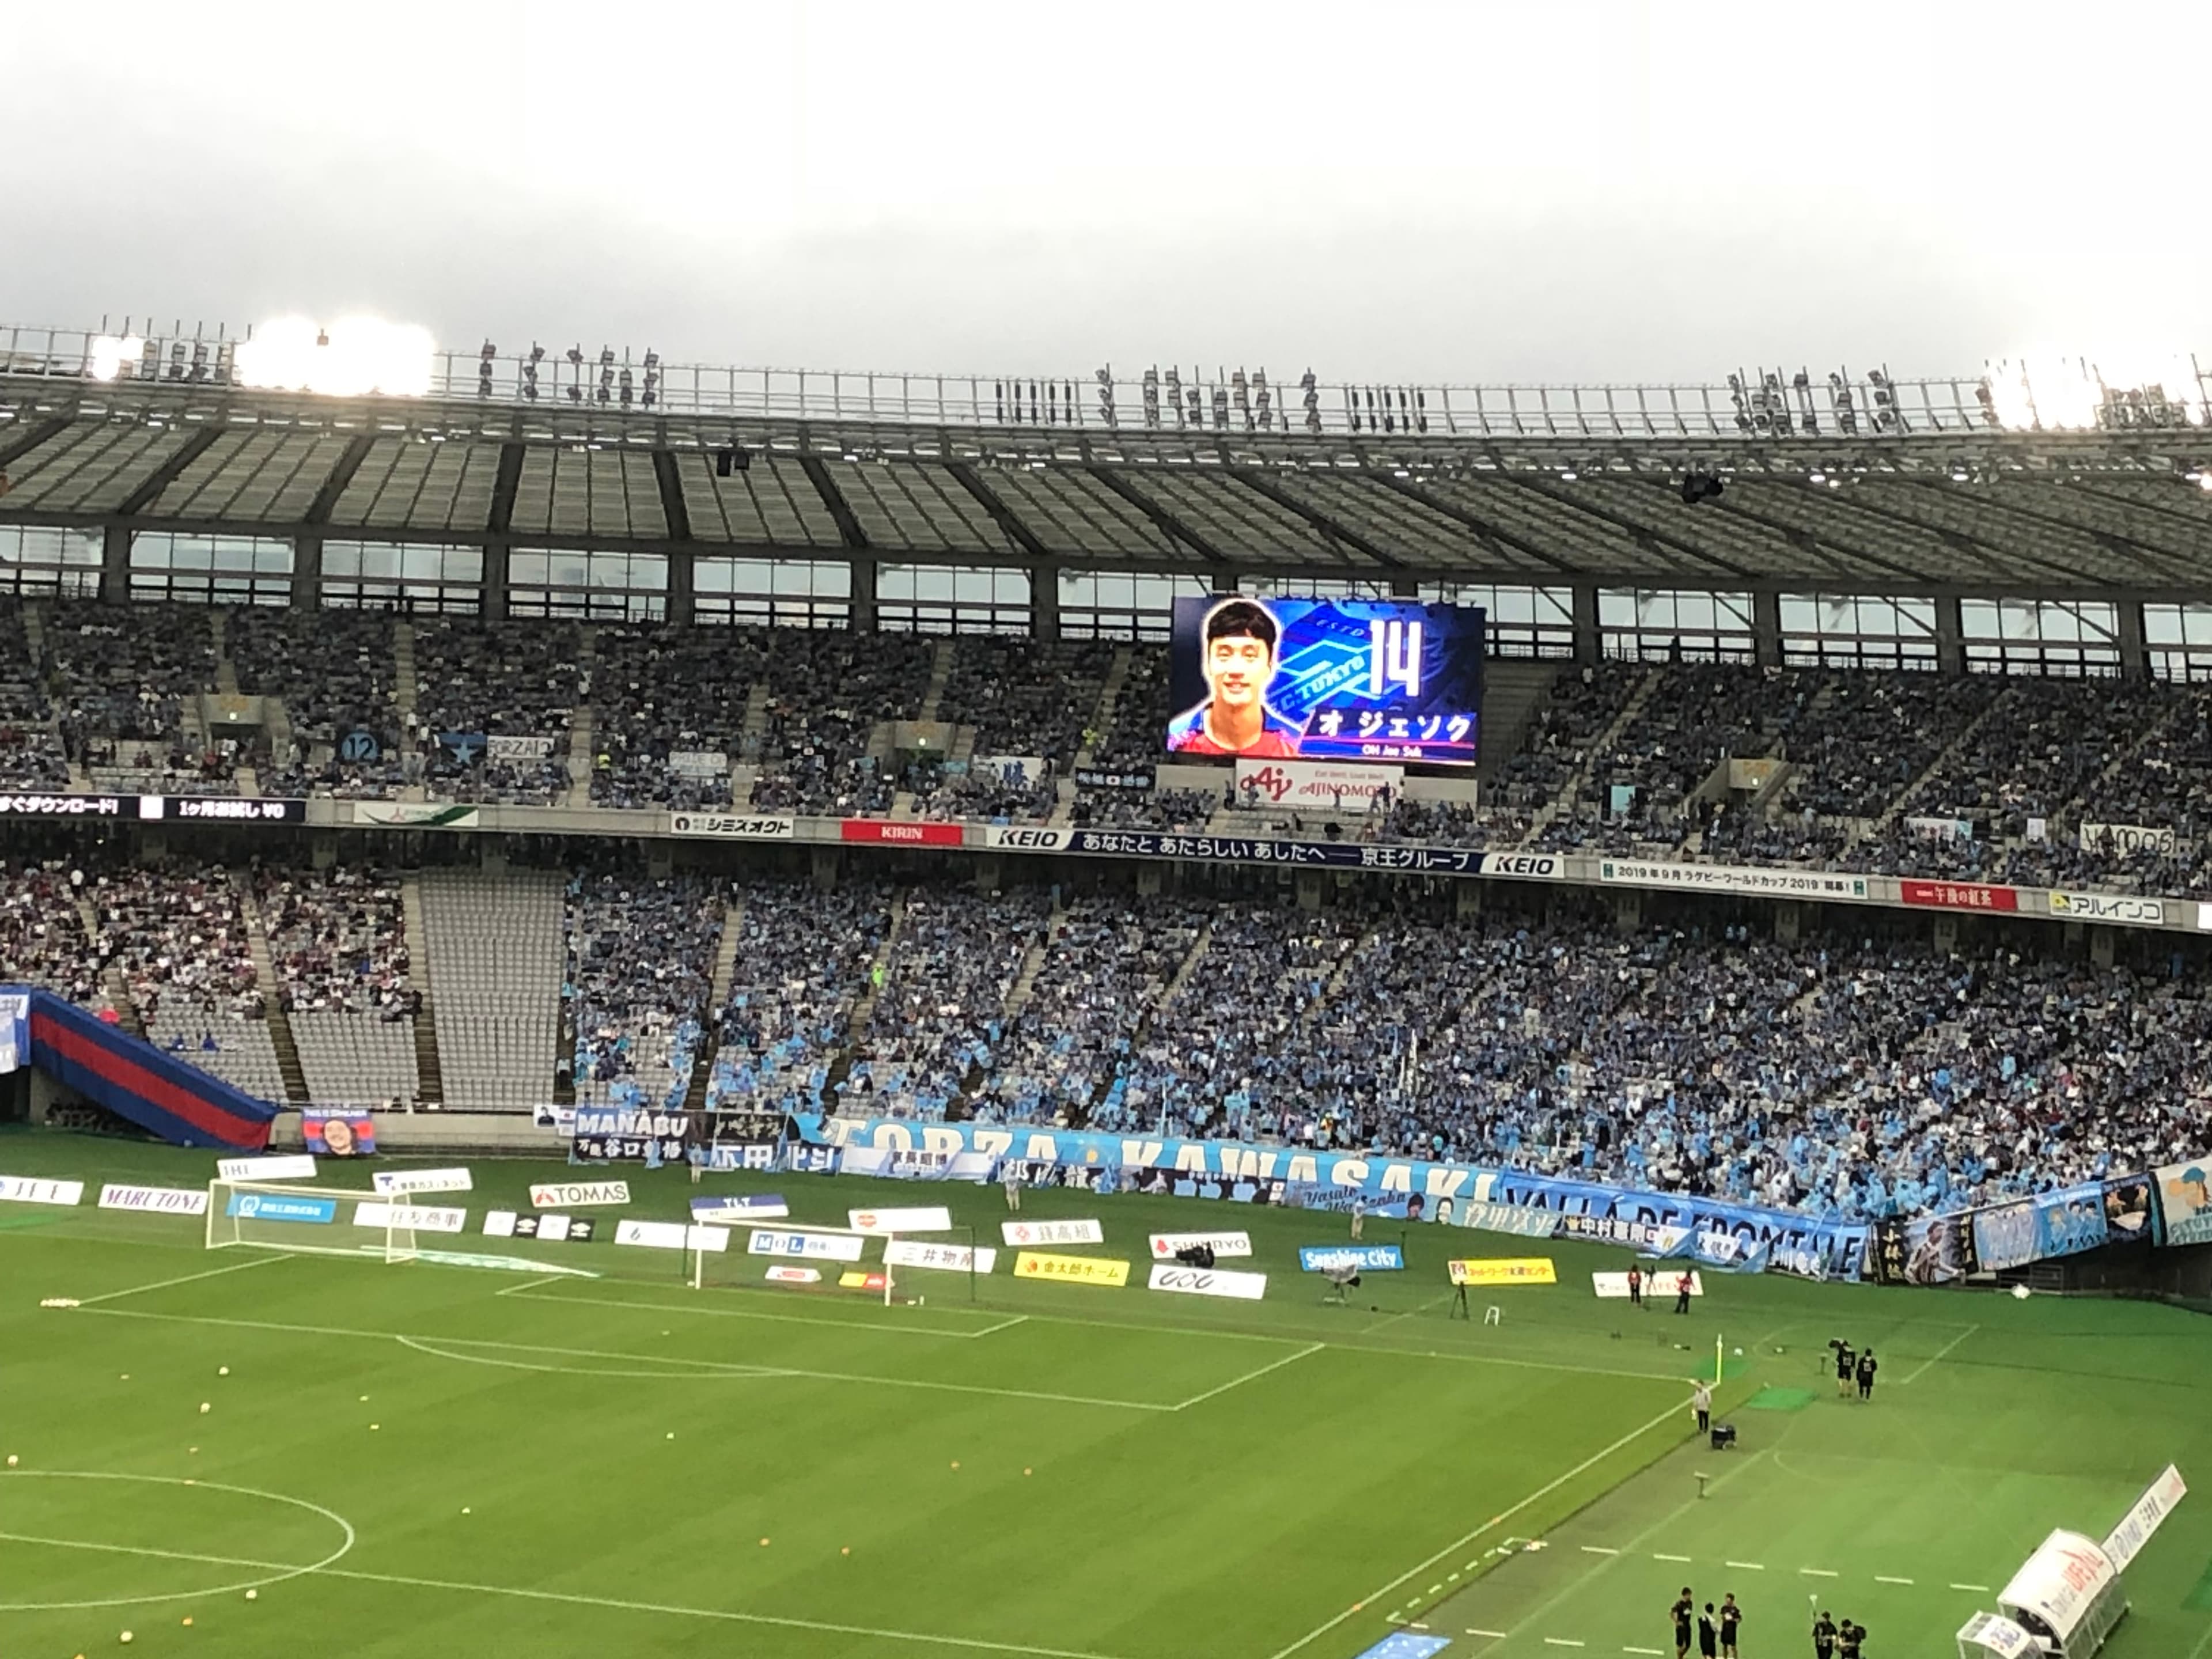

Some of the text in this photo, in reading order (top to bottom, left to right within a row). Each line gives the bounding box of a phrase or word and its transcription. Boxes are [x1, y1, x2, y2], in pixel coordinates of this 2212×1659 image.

[1370, 620, 1422, 697] 14
[1298, 782, 1397, 798] AJINOMOO
[881, 827, 923, 839] KIRIN
[998, 830, 1059, 847] KEIO
[1083, 834, 1469, 870] あなたと あたらしい あしたへ 京王グループ
[1494, 856, 1554, 874] KEIO
[2072, 897, 2161, 920] アルインコ
[577, 1112, 689, 1138] MANABU
[224, 1165, 249, 1176] IHI
[554, 1184, 627, 1203] TOMAS
[1305, 1249, 1397, 1268] Sunshine City
